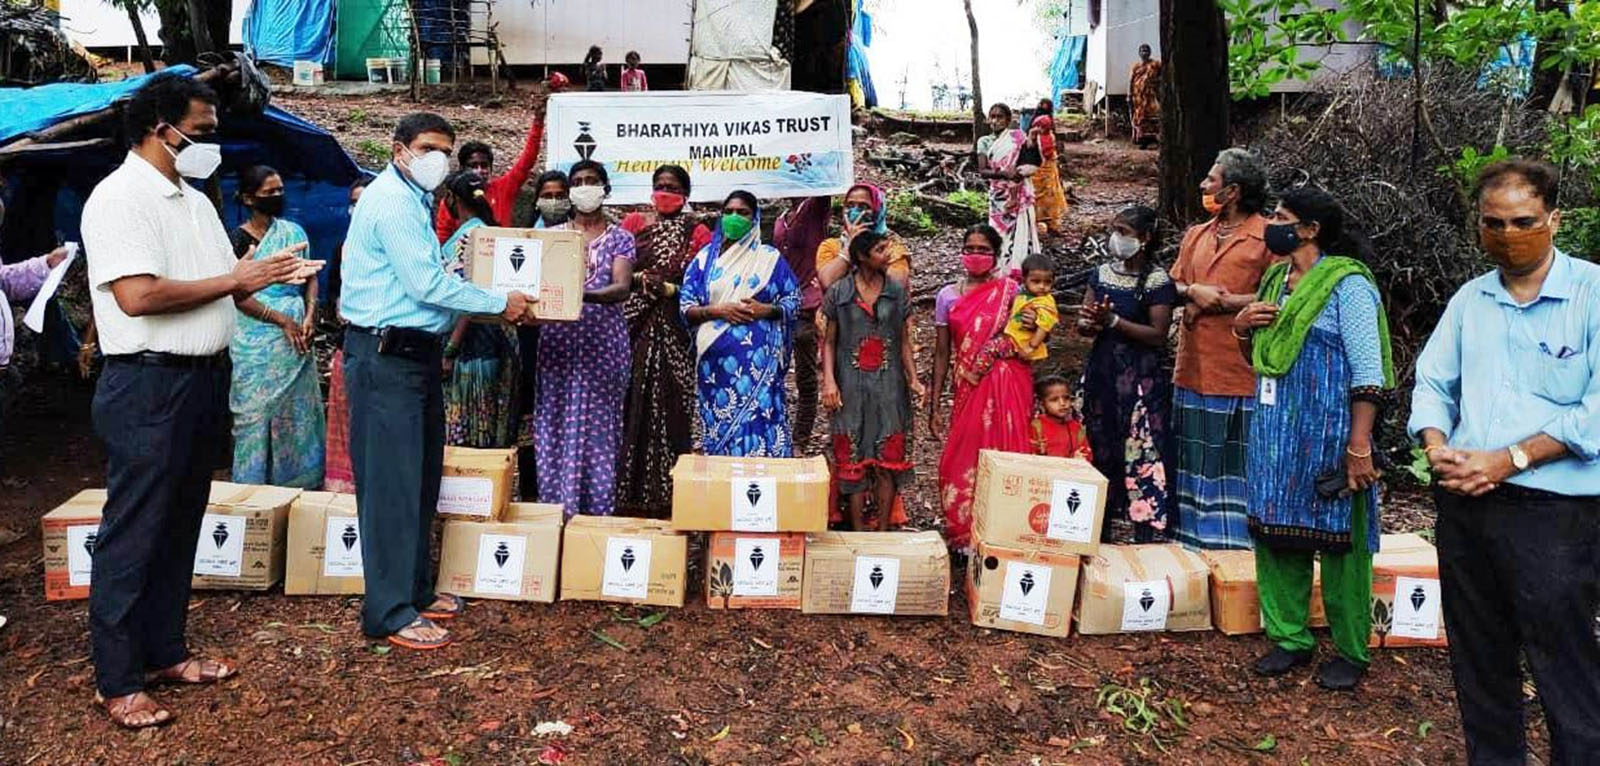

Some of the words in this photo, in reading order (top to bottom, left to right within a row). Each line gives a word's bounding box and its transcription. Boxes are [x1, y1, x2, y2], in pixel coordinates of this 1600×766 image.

[616, 122, 719, 138] BHARATHIYA
[724, 120, 771, 136] VIKAS
[776, 116, 831, 133] TRUST
[689, 143, 757, 160] MANIPAL
[699, 155, 781, 173] Welcome
